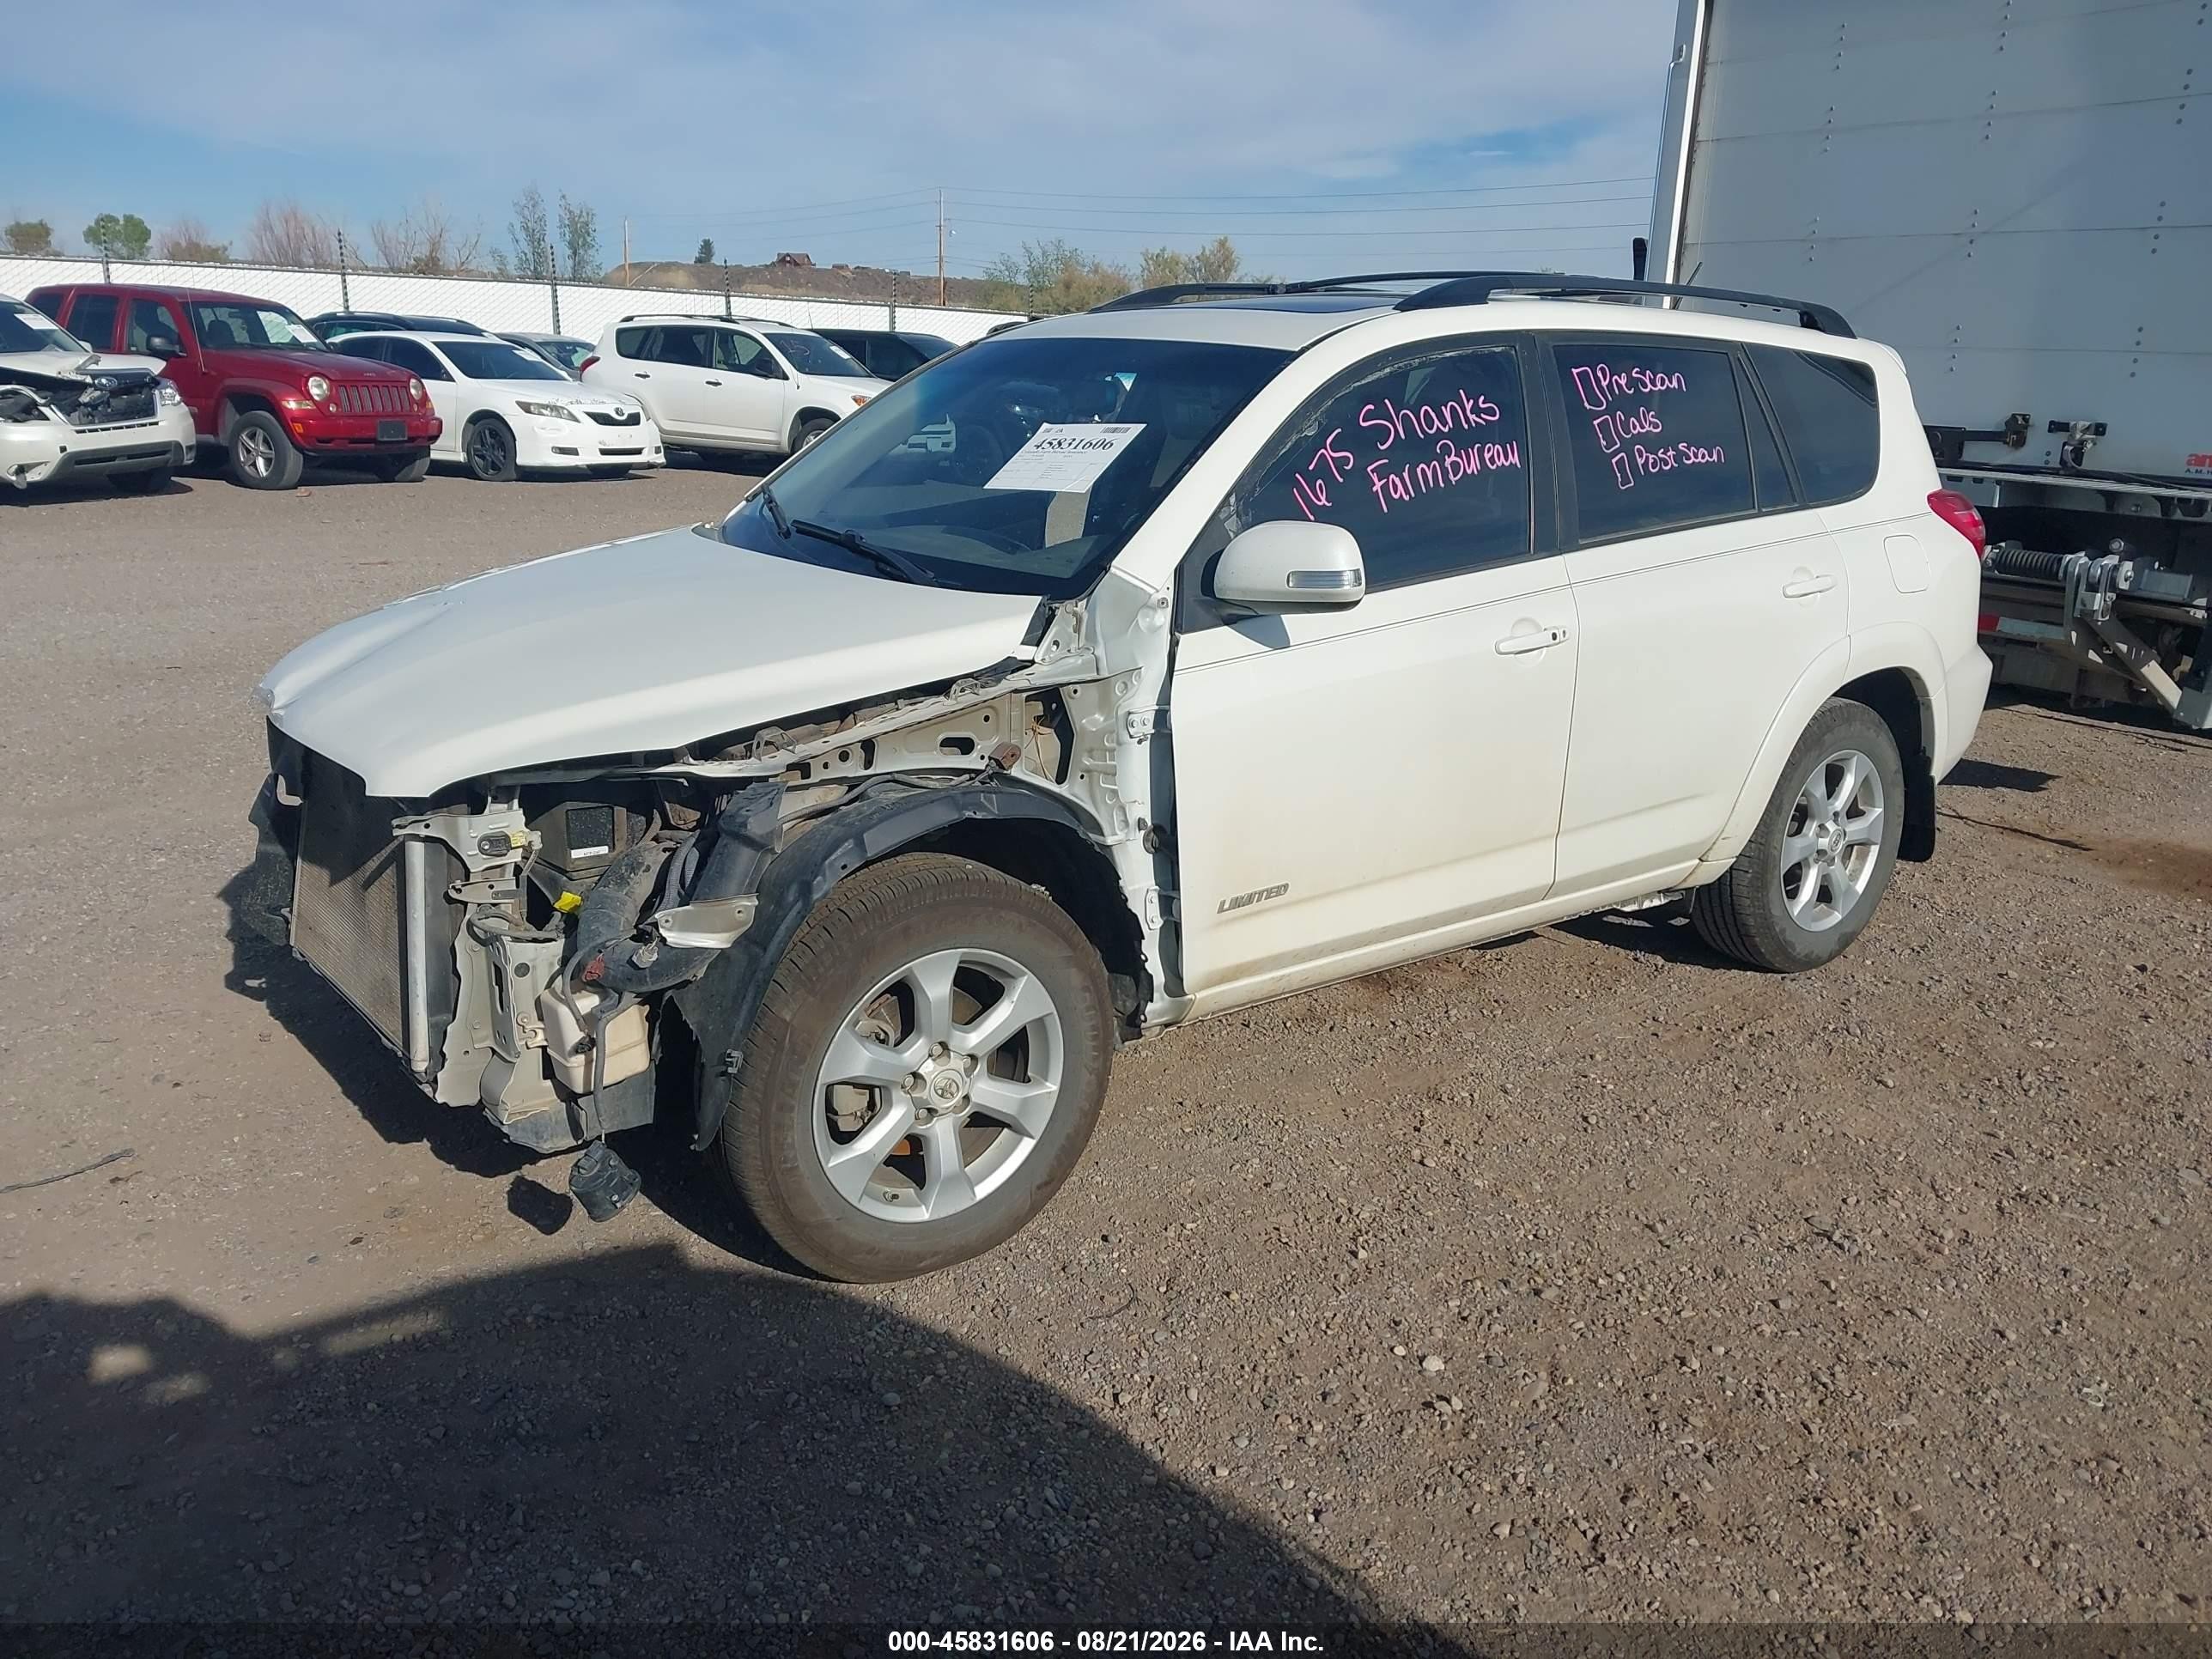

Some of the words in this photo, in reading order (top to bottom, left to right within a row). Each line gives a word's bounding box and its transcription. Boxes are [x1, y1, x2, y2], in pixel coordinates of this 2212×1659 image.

[1359, 388, 1500, 450] Shanks
[1616, 406, 1662, 439] Cals
[1033, 437, 1119, 451] 45831606
[1216, 881, 1290, 915] LIMITED
